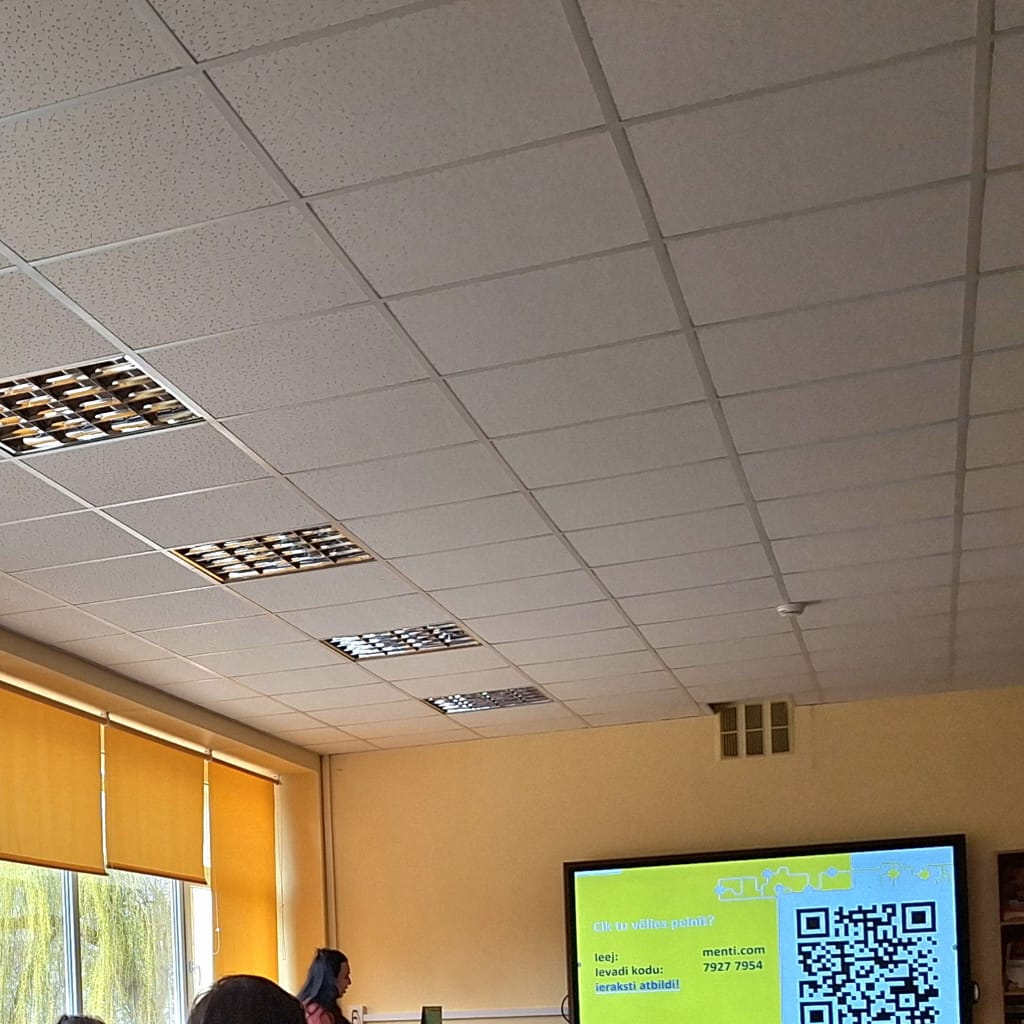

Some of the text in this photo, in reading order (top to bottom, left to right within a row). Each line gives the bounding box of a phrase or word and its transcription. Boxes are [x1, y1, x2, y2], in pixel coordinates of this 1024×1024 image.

[702, 944, 766, 957] menti.com
[631, 964, 664, 976] kodu:
[703, 960, 763, 972] 7927 7954
[595, 978, 680, 992] ieraksti atbildi!
